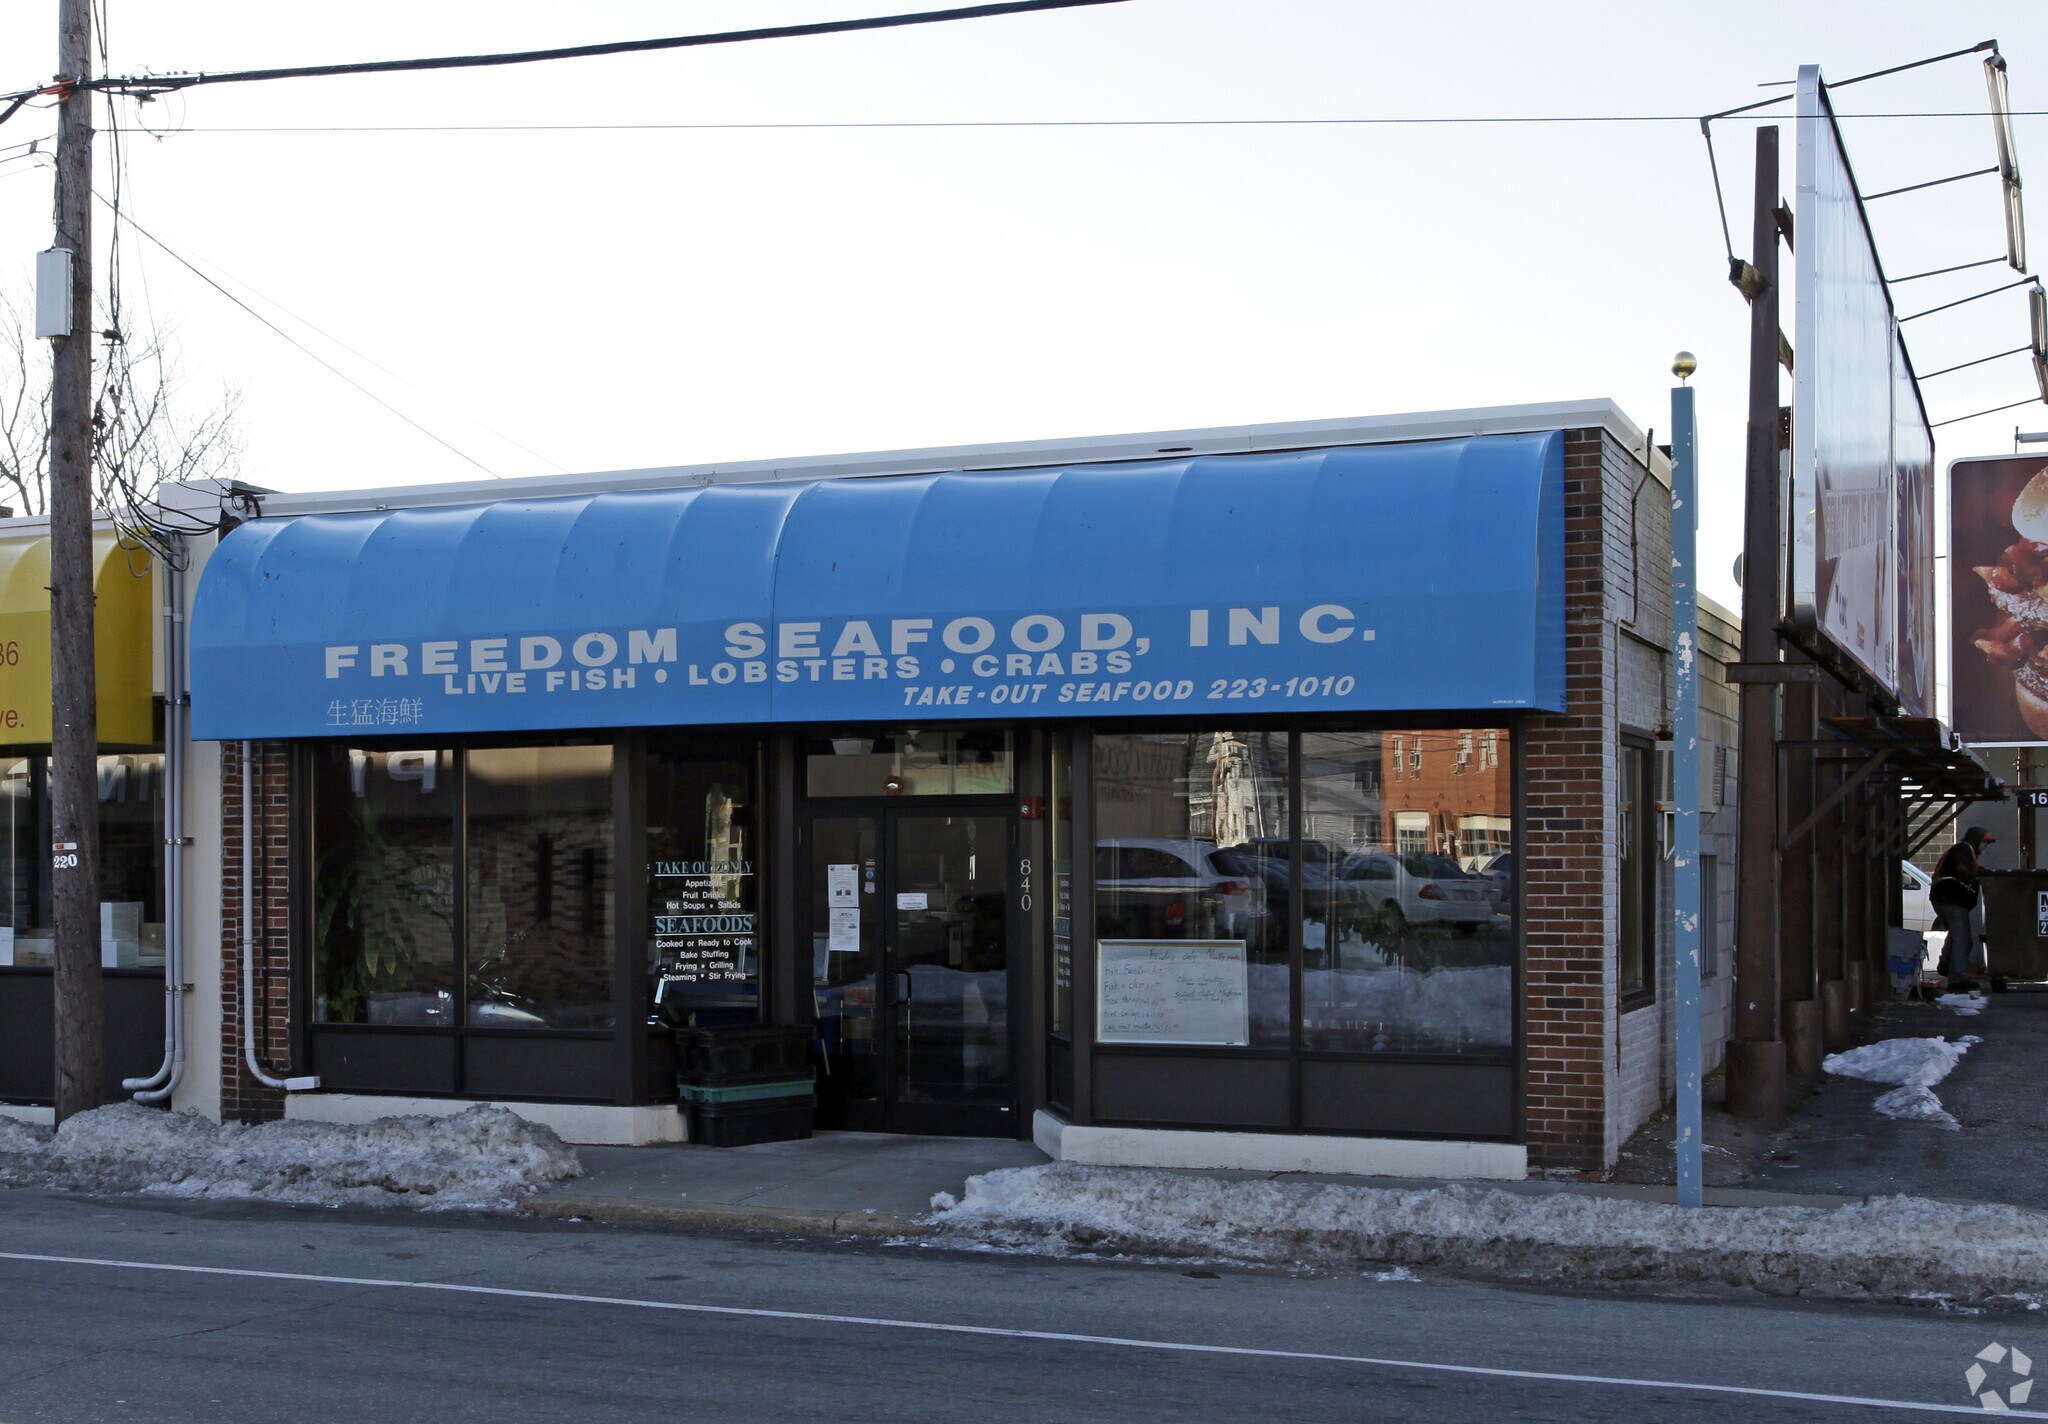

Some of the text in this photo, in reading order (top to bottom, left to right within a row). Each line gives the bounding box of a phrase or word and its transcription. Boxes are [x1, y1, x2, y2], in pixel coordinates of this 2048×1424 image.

[325, 604, 1376, 679] FREEDOM SEAFOOD, INC.
[444, 650, 1132, 695] LIVE FISH LOBSTERS CRABS
[903, 675, 1356, 706] TAKE-OUT SEAFOOD 223-1010
[326, 697, 423, 727] 生猛海鮮
[53, 853, 78, 869] 220
[656, 861, 689, 874] TAKE
[720, 861, 753, 873] ONLY
[685, 879, 723, 888] Appetiz
[1020, 858, 1032, 911] 840
[682, 891, 725, 899] Fruit Drinks
[666, 901, 741, 910] Hot Soups Salads
[656, 916, 753, 934] SEAFOODS
[656, 940, 684, 948] Cooked
[698, 939, 720, 948] Ready
[733, 938, 752, 946] Cook
[680, 950, 729, 959] Bake Stuffing
[675, 961, 734, 971] Frying Grilling
[663, 971, 746, 982] Steaming Stir Frying
